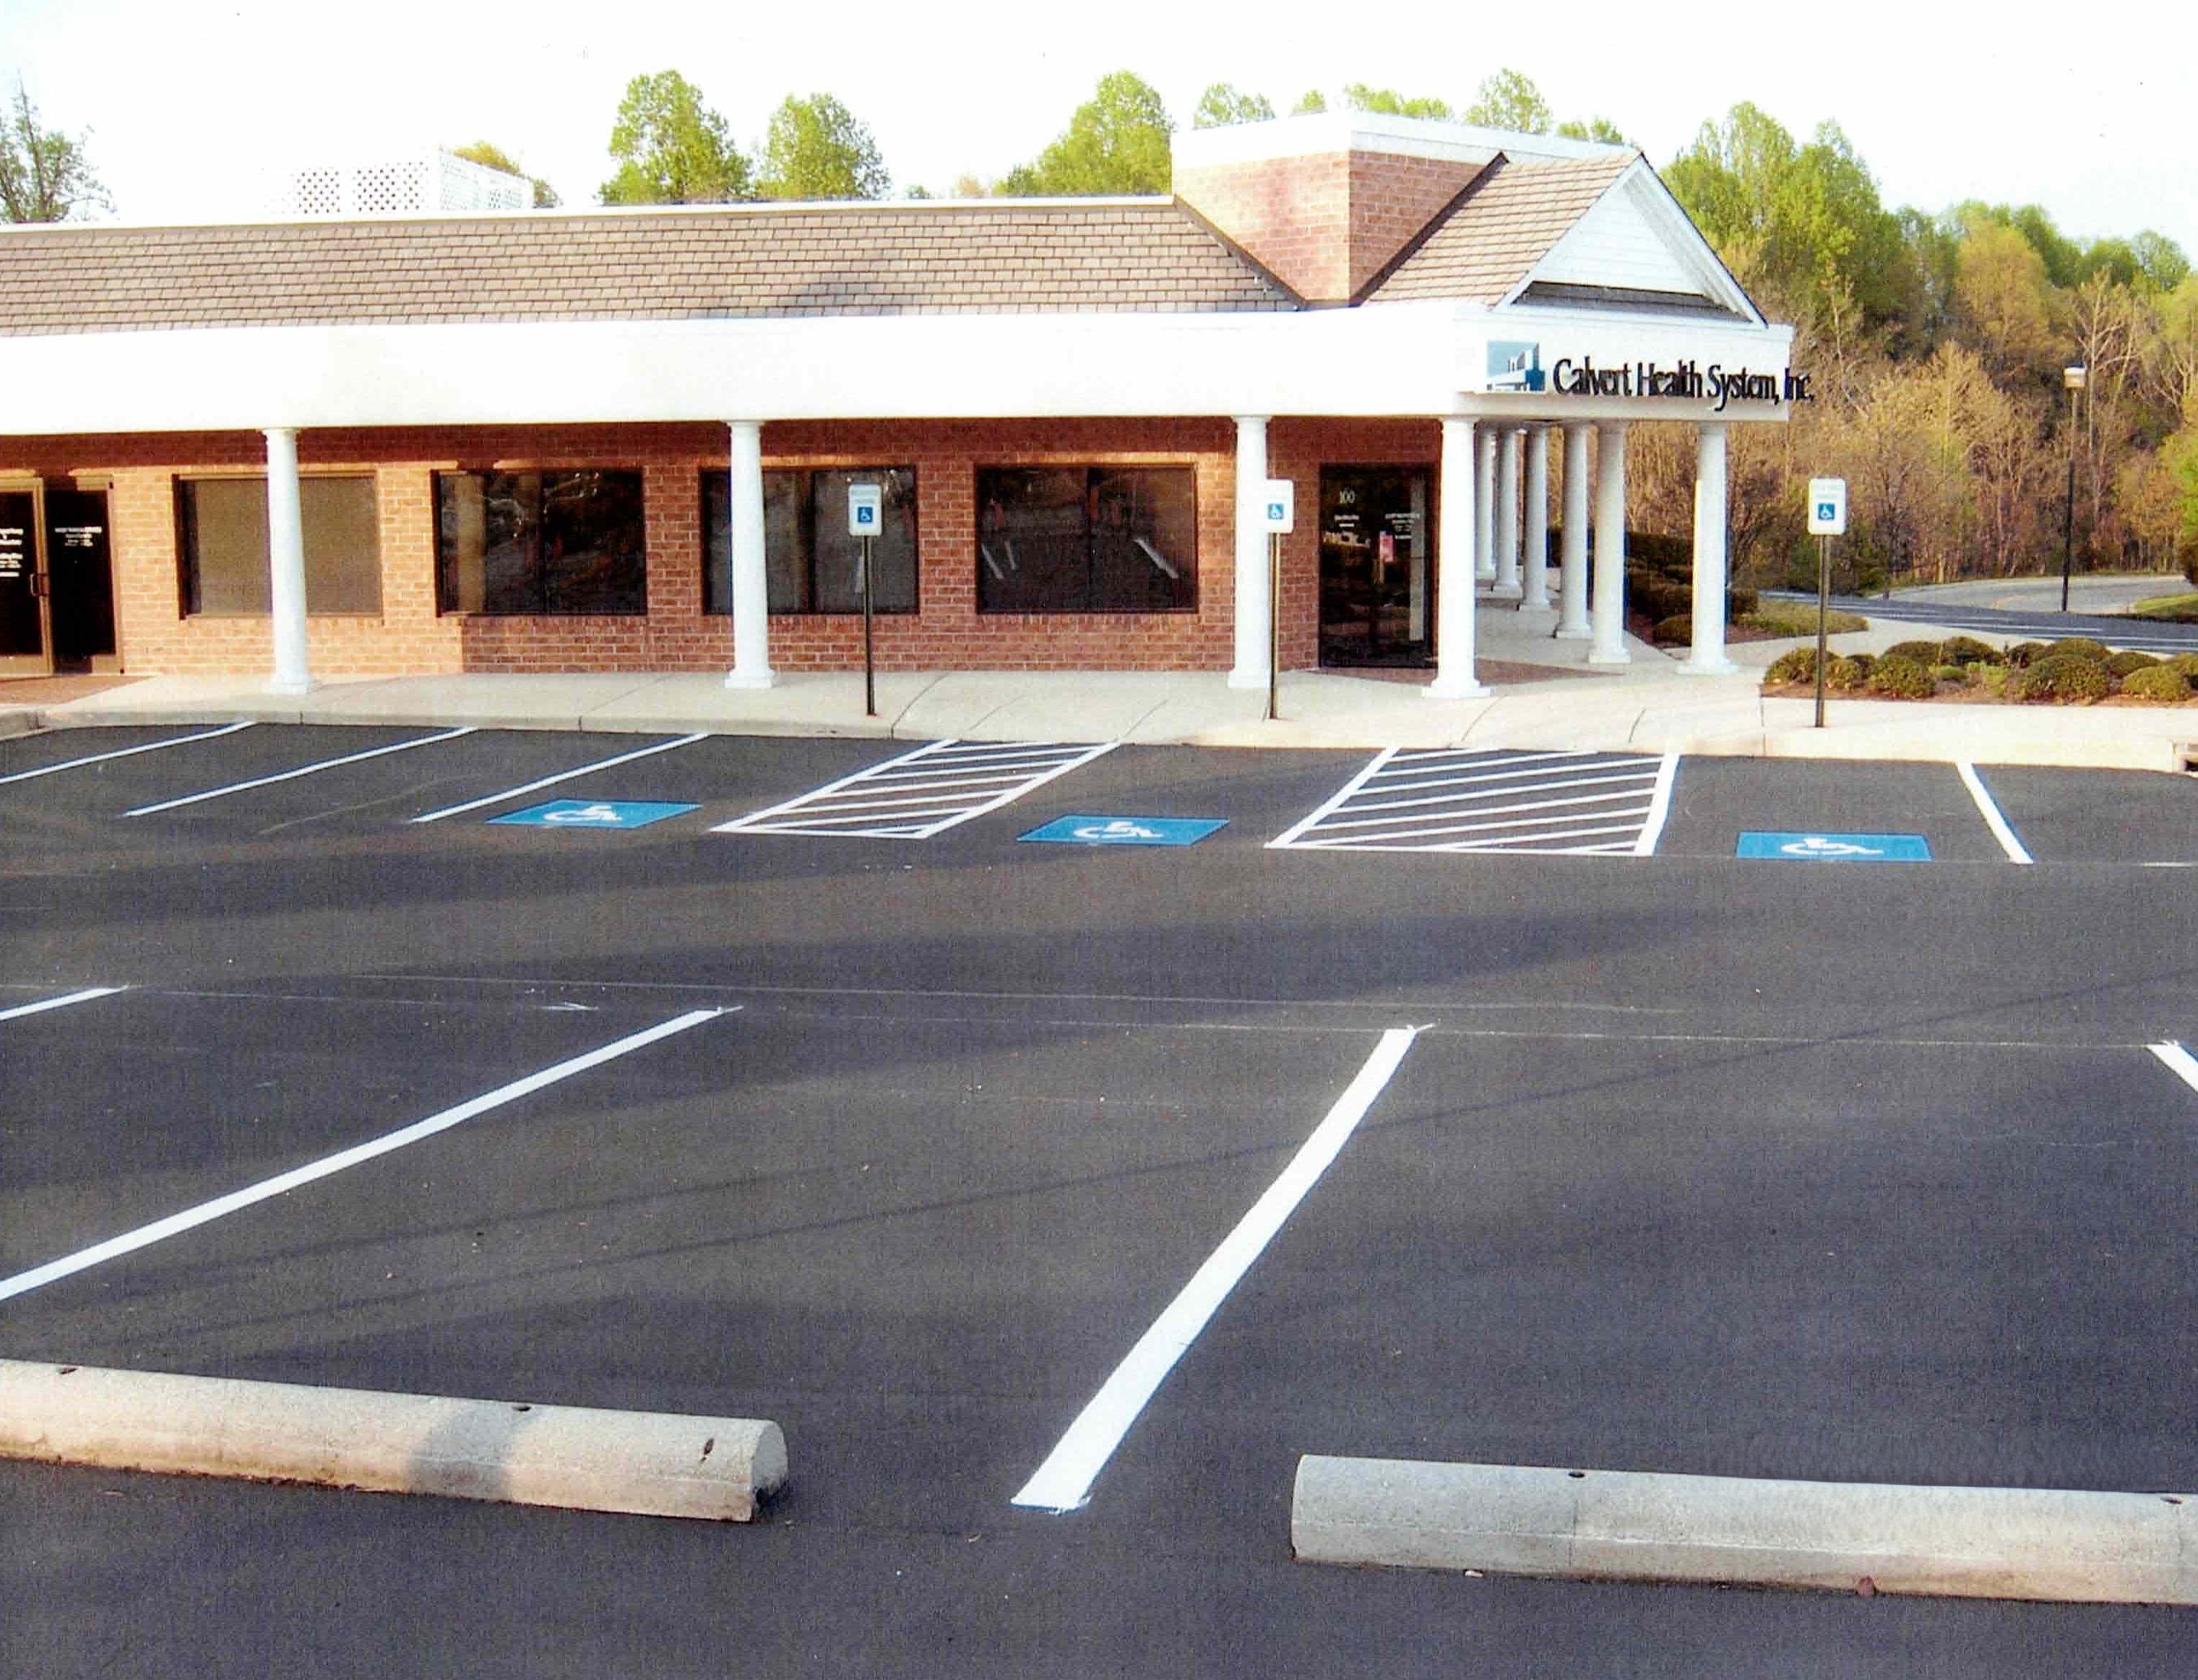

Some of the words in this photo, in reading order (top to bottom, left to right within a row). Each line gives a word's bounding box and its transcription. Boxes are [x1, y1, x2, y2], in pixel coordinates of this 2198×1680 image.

[1553, 356, 1632, 396] Calvert
[1637, 360, 1702, 398] Health
[1707, 364, 1780, 411] System,
[1784, 367, 1813, 402] Inc.
